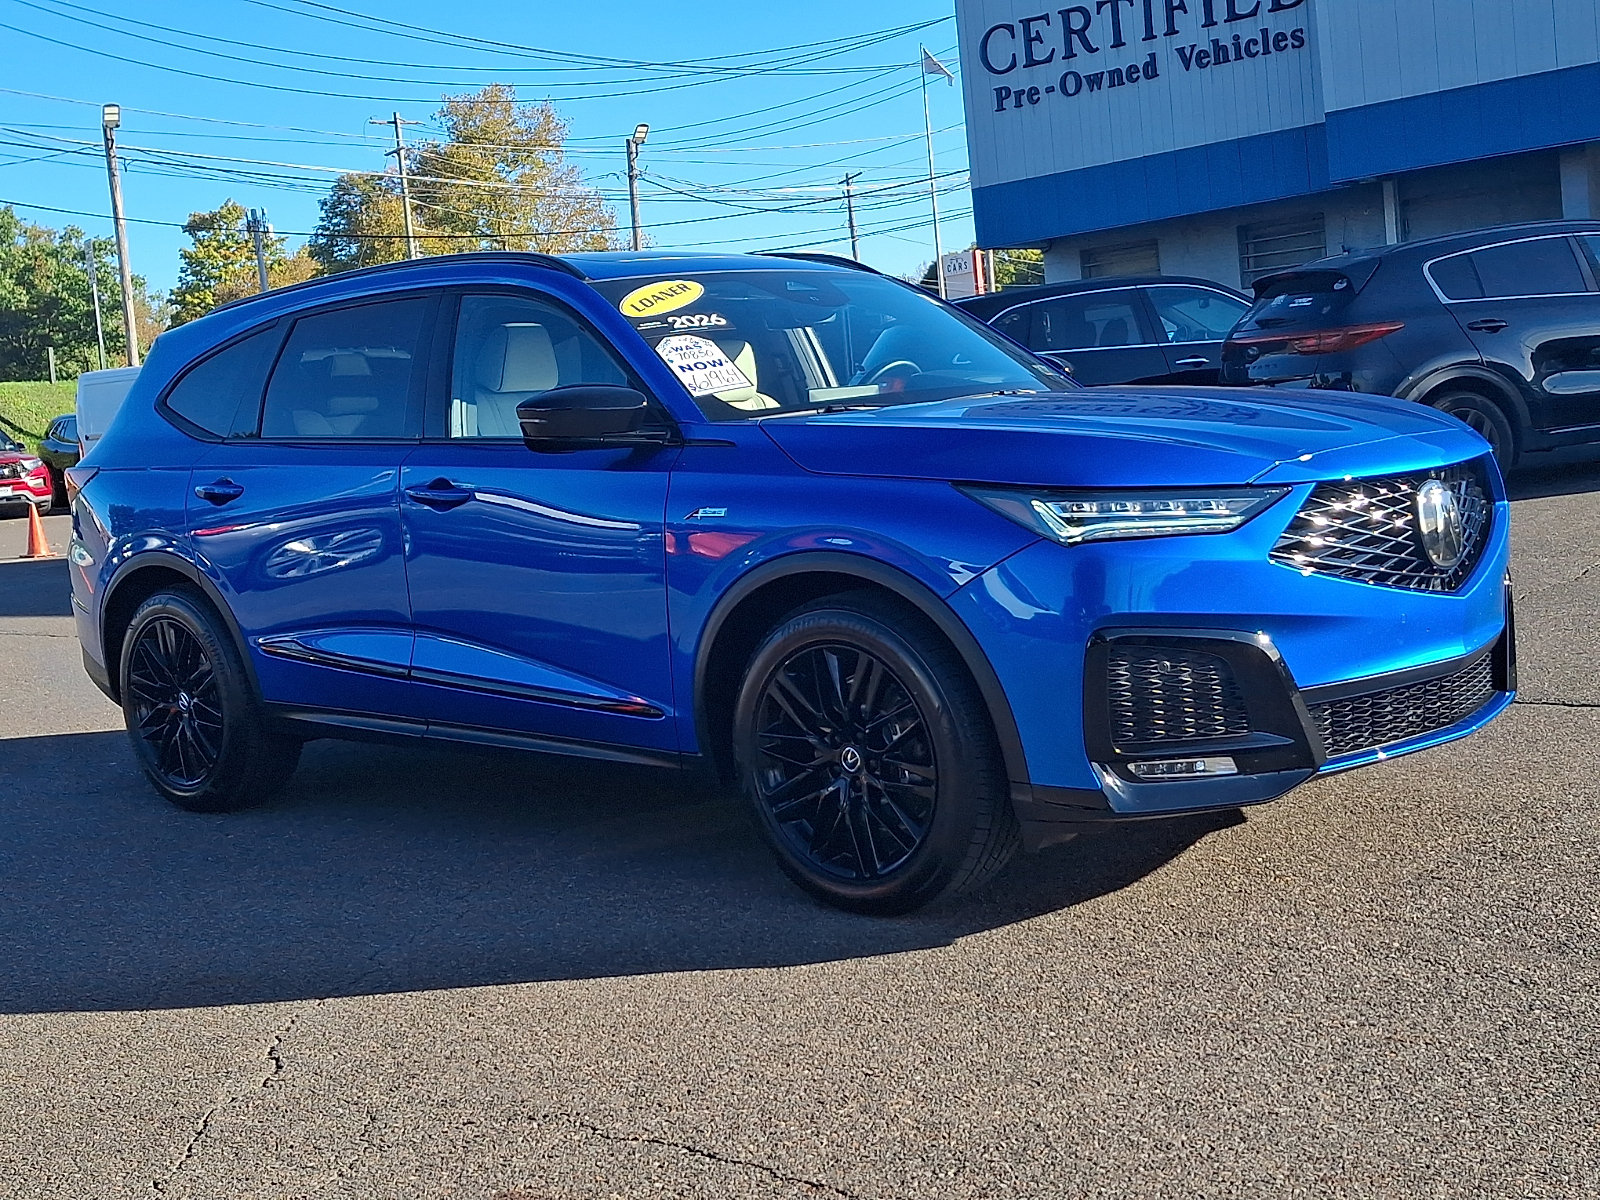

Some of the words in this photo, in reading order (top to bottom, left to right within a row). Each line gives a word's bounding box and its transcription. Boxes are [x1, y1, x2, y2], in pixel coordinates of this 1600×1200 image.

[979, 0, 1303, 75] CERTIFI
[993, 53, 1160, 112] Pre-Owned
[1174, 27, 1306, 72] Vehicles
[946, 261, 968, 273] CARS
[630, 282, 692, 313] LOANER
[667, 313, 727, 329] 2026
[671, 343, 703, 353] WAS
[678, 358, 724, 373] NOW
